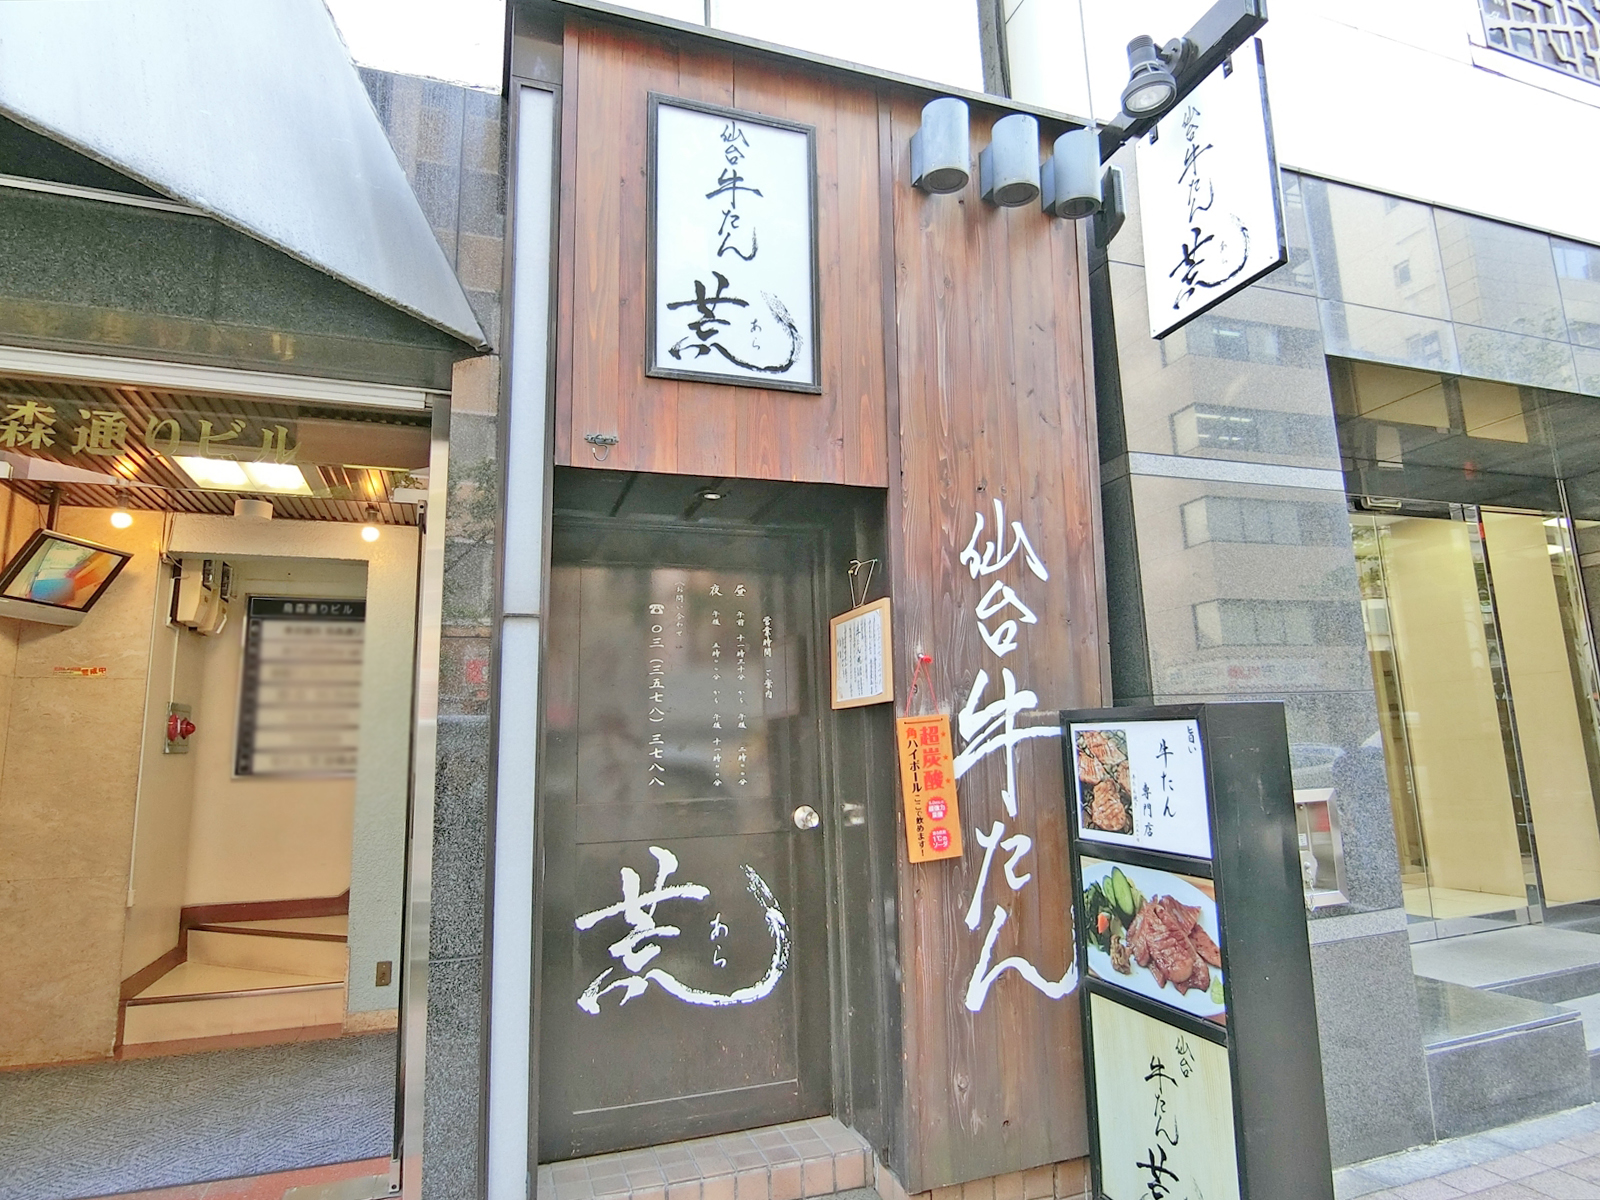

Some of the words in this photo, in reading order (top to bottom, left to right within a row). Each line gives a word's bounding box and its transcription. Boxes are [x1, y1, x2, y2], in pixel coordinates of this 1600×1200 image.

[705, 120, 764, 262] 仙台牛たん
[1178, 105, 1214, 223] 仙台牛たん
[750, 318, 762, 351] あら
[709, 583, 723, 597] 夜
[733, 584, 747, 597] 昼
[736, 610, 745, 627] 午前
[762, 616, 773, 658] 営業時間
[920, 725, 945, 792] 超炭酸
[954, 498, 1079, 1012] 仙台牛たん
[1155, 738, 1177, 818] 牛たん
[1141, 781, 1154, 837] 専門店
[709, 912, 729, 968] あら
[1175, 1034, 1196, 1079] 仙台
[1144, 1055, 1179, 1146] 牛たん
